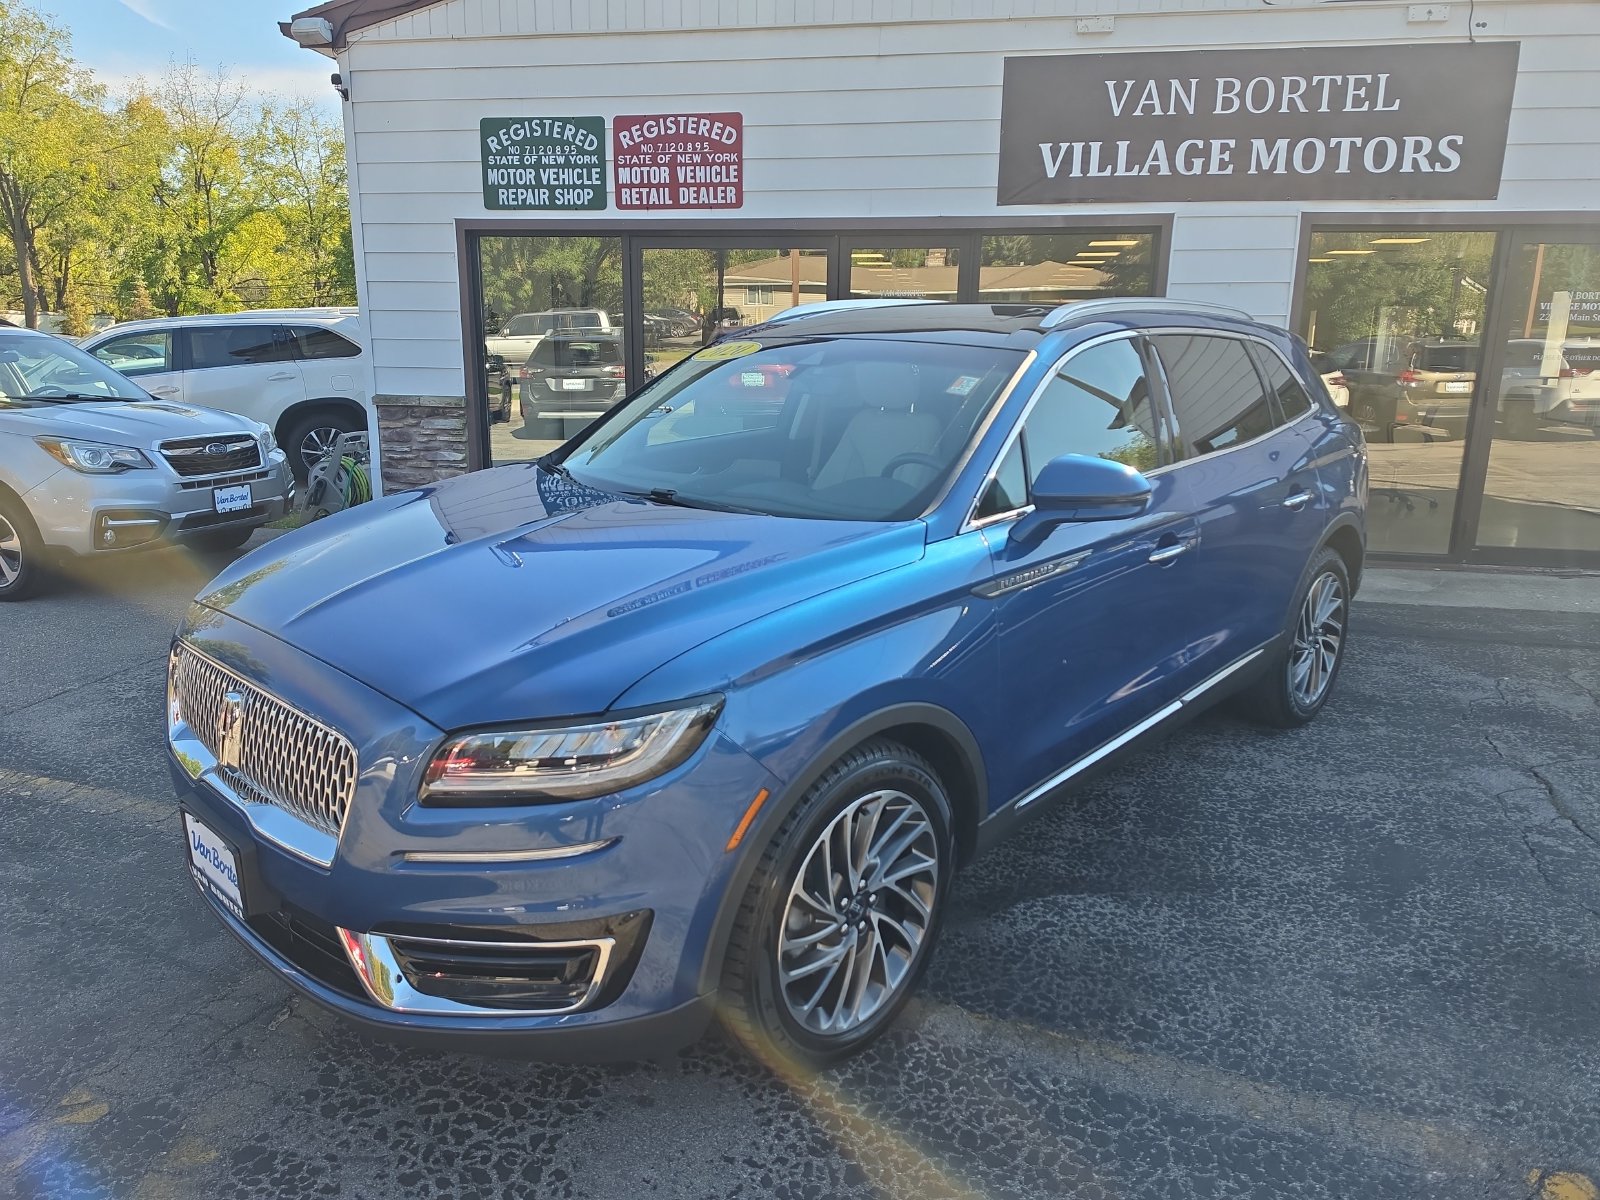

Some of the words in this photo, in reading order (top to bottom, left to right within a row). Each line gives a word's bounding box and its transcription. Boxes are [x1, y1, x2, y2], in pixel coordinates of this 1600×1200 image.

[1105, 78, 1199, 117] VAN
[1212, 73, 1400, 115] BORTEL
[486, 119, 598, 153] REGISTERED
[618, 117, 737, 149] REGISTERED
[524, 145, 577, 154] 7120895
[657, 142, 710, 152] 7120895
[488, 156, 519, 164] STATE
[524, 156, 538, 164] OF
[541, 155, 565, 164] NEW
[569, 155, 599, 164] YORK
[618, 155, 652, 164] STATE
[657, 155, 672, 163] OF
[678, 154, 702, 163] NEW
[707, 153, 738, 162] YORK
[1039, 139, 1236, 178] VILLAGE
[1247, 135, 1464, 174] MOTORS
[487, 168, 536, 185] MOTOR
[540, 168, 601, 185] VEHICLE
[618, 167, 670, 184] MOTOR
[677, 165, 739, 183] VEHICLE
[499, 189, 549, 205] REPAIR
[555, 188, 594, 205] SHOP
[621, 188, 673, 205] RETAIL
[680, 187, 736, 204] DEALER
[1569, 313, 1590, 321] Main
[216, 496, 229, 505] Van
[230, 491, 249, 502] Bortel
[191, 829, 212, 863] Van
